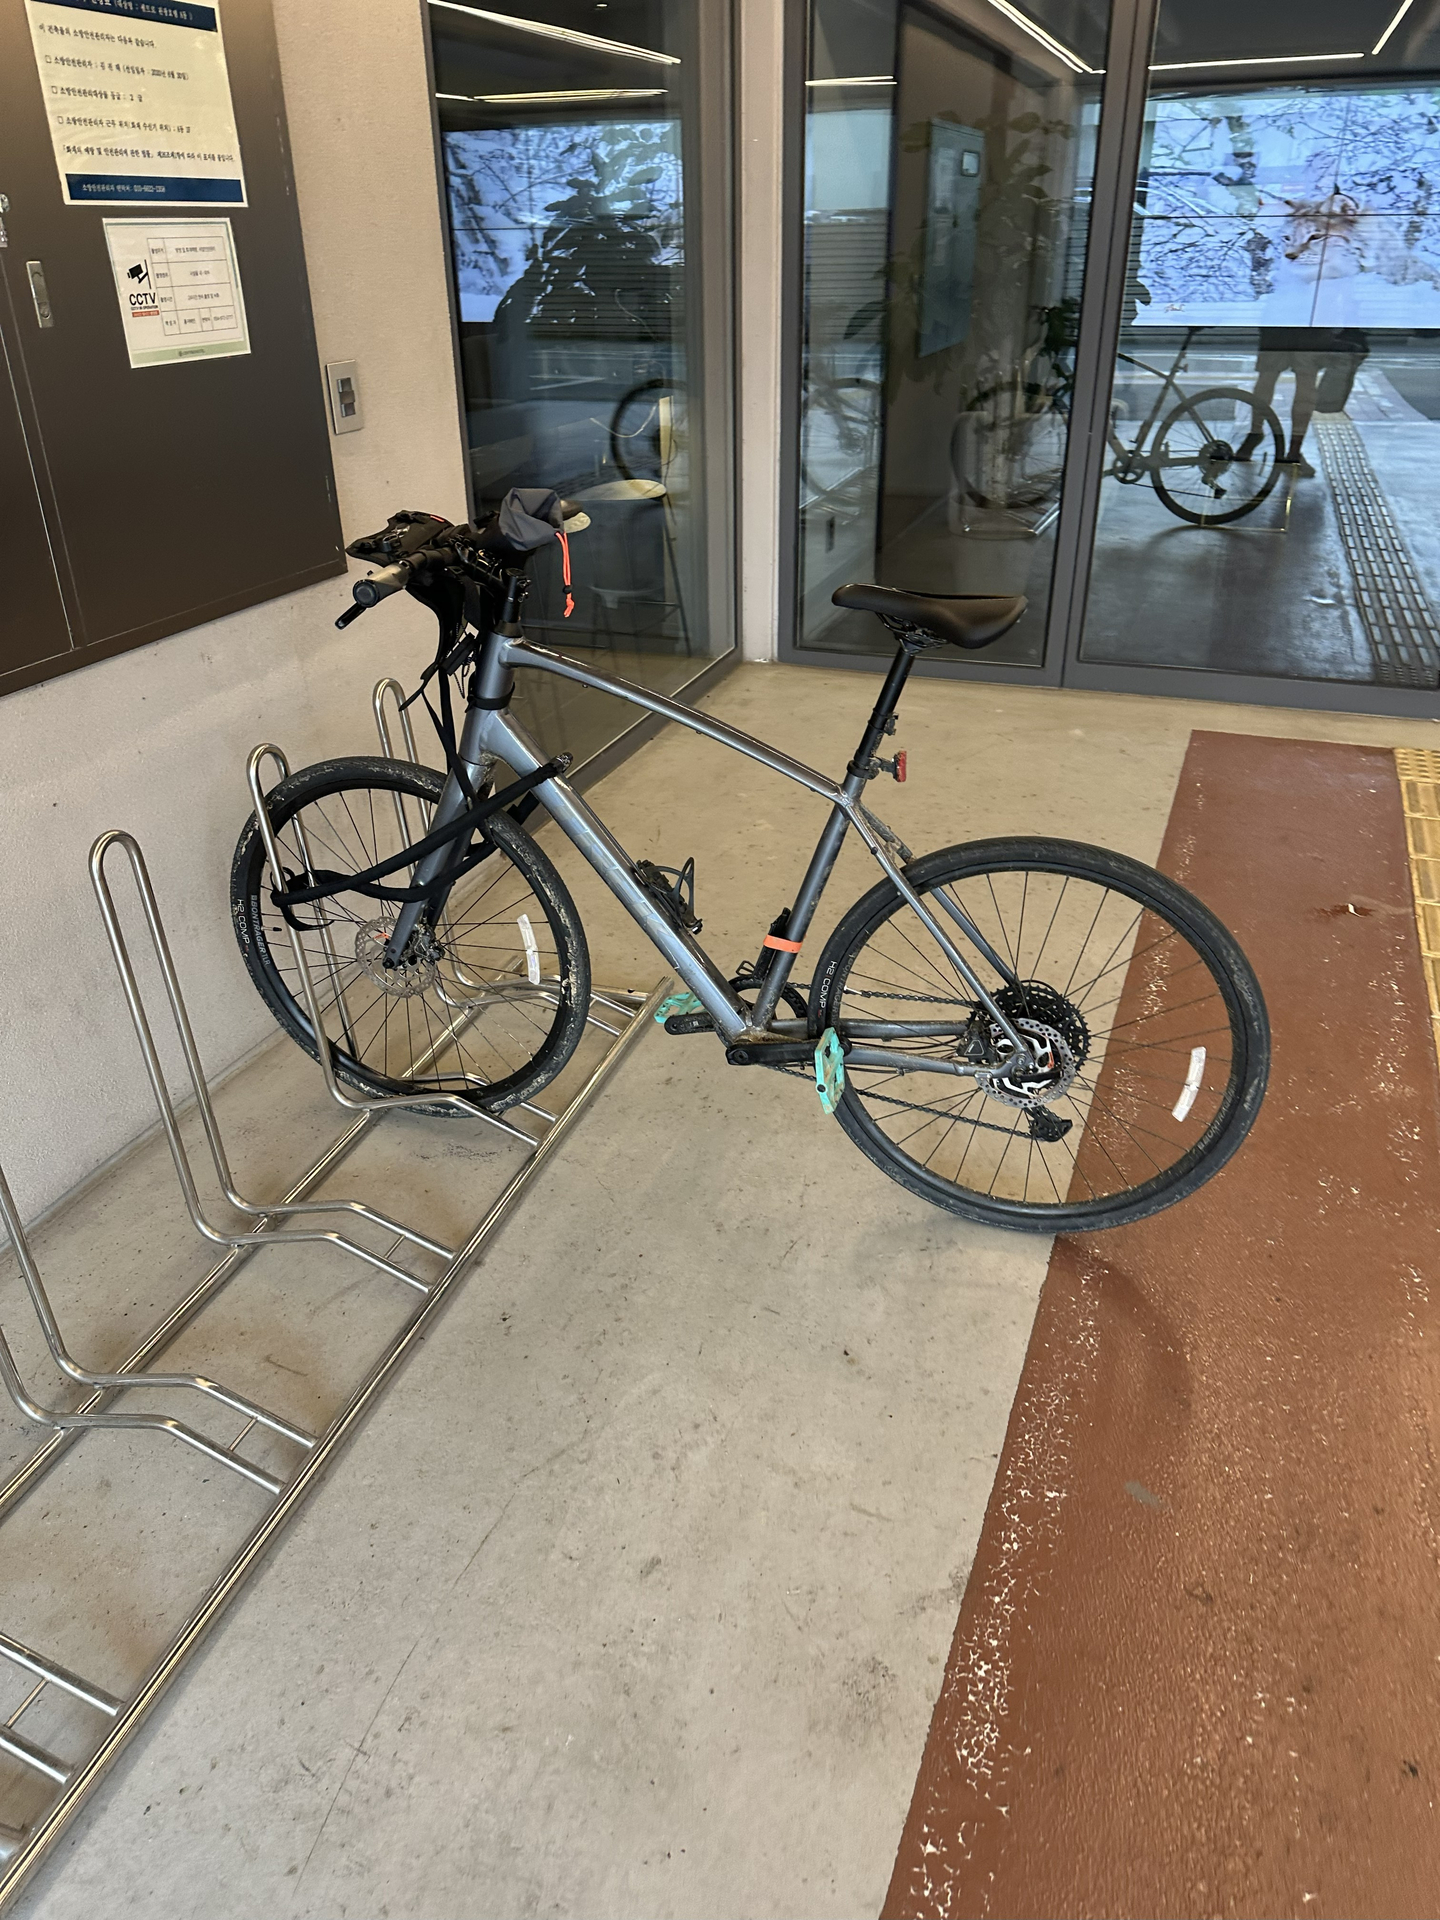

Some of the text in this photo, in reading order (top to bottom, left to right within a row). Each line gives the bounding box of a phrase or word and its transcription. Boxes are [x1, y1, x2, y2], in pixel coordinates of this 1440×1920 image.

[129, 292, 156, 306] CCTV
[237, 898, 245, 912] H2
[238, 915, 250, 944] COMP
[250, 900, 271, 967] BONTRAGER TLR
[826, 960, 838, 975] H2
[819, 977, 831, 1008] COMP
